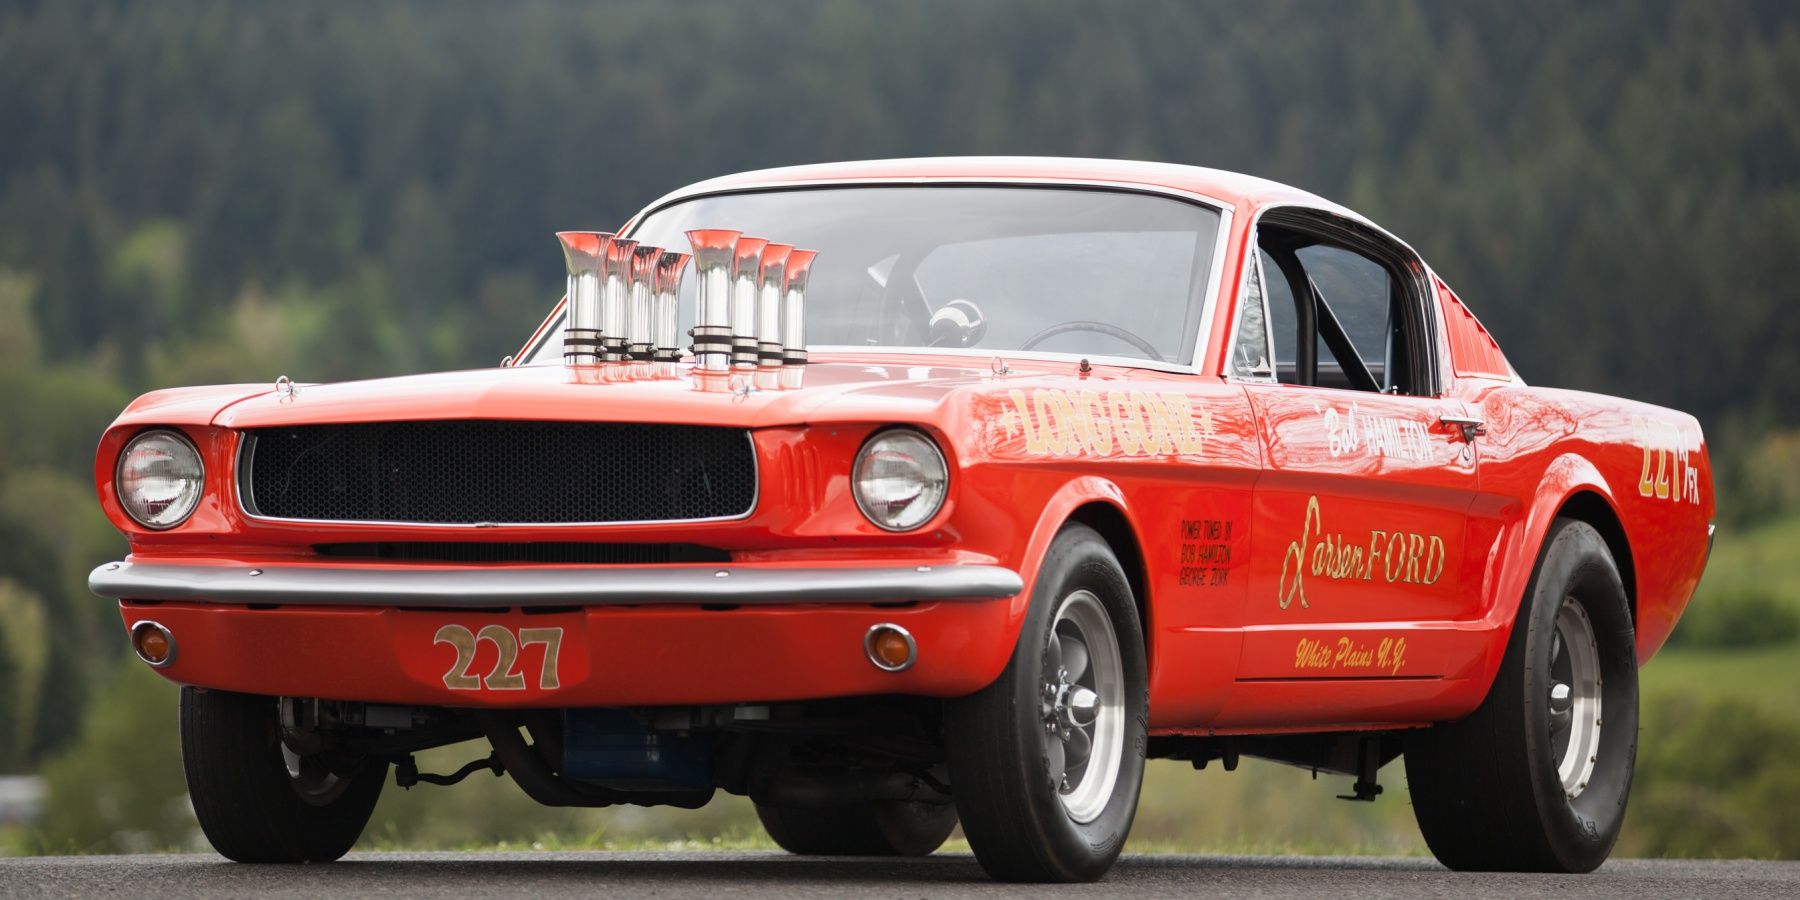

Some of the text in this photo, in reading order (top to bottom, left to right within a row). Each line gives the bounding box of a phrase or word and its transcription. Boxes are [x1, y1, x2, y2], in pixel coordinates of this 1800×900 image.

[1361, 415, 1433, 461] HAMILTON
[1181, 544, 1231, 565] BOB HAMILTON
[1279, 495, 1445, 610] Larsen FORD
[1179, 566, 1207, 586] GEORGE
[434, 624, 563, 690] 227
[1295, 637, 1331, 668] White
[1332, 636, 1373, 669] Plains
